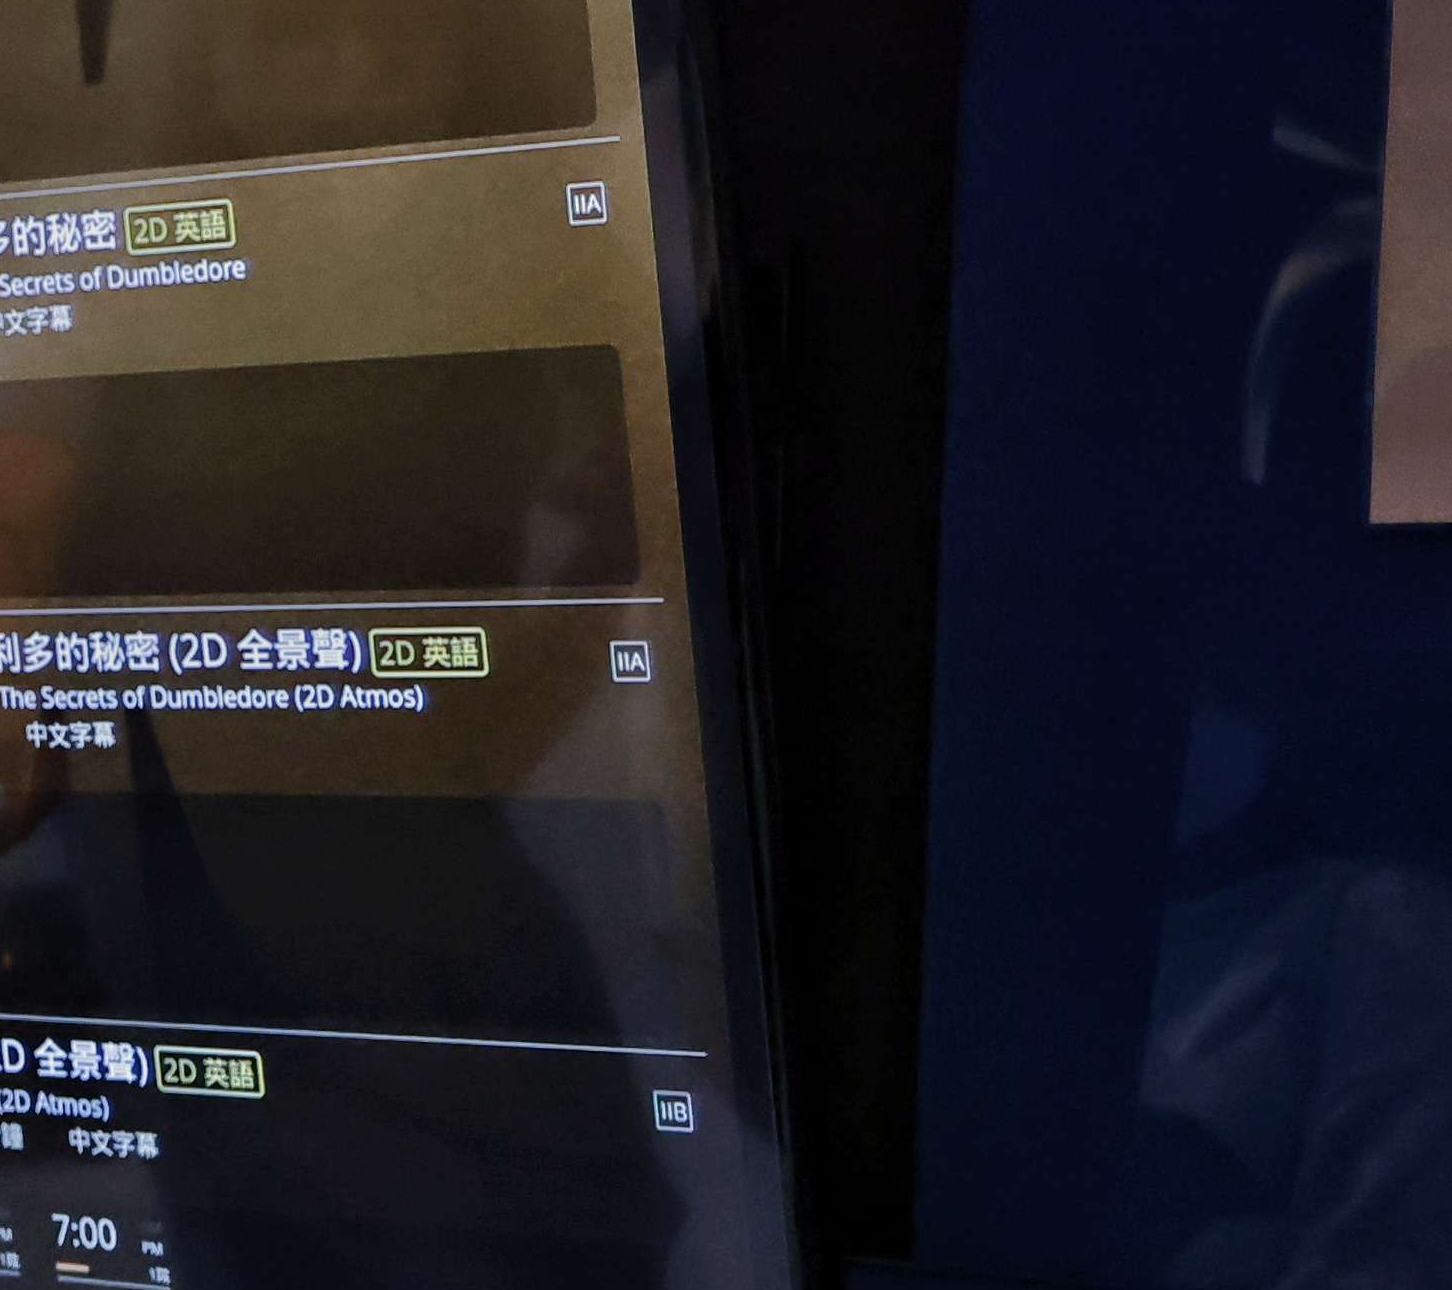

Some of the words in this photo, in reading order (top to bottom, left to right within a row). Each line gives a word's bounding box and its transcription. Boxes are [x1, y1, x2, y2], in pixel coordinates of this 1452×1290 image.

[133, 216, 168, 245] 2D
[172, 209, 227, 243] 英語
[79, 264, 103, 291] of
[106, 258, 247, 291] Dumbledore
[168, 631, 228, 676] (2D
[236, 627, 362, 674] 全景聲)
[378, 640, 416, 667] 2D
[421, 636, 480, 668] 英語
[40, 686, 119, 710] Secrets
[122, 685, 145, 709] of
[150, 684, 290, 710] Dumbledore
[293, 684, 336, 712] (2D
[339, 684, 424, 712] Atmos)
[25, 720, 117, 749] 中文字幕
[33, 1036, 150, 1088] 全景聲)
[162, 1057, 197, 1084] 2D
[202, 1056, 255, 1090] 英語
[34, 1090, 111, 1121] Atmos)
[67, 1126, 160, 1159] 中文字幕
[50, 1212, 118, 1252] 7:00
